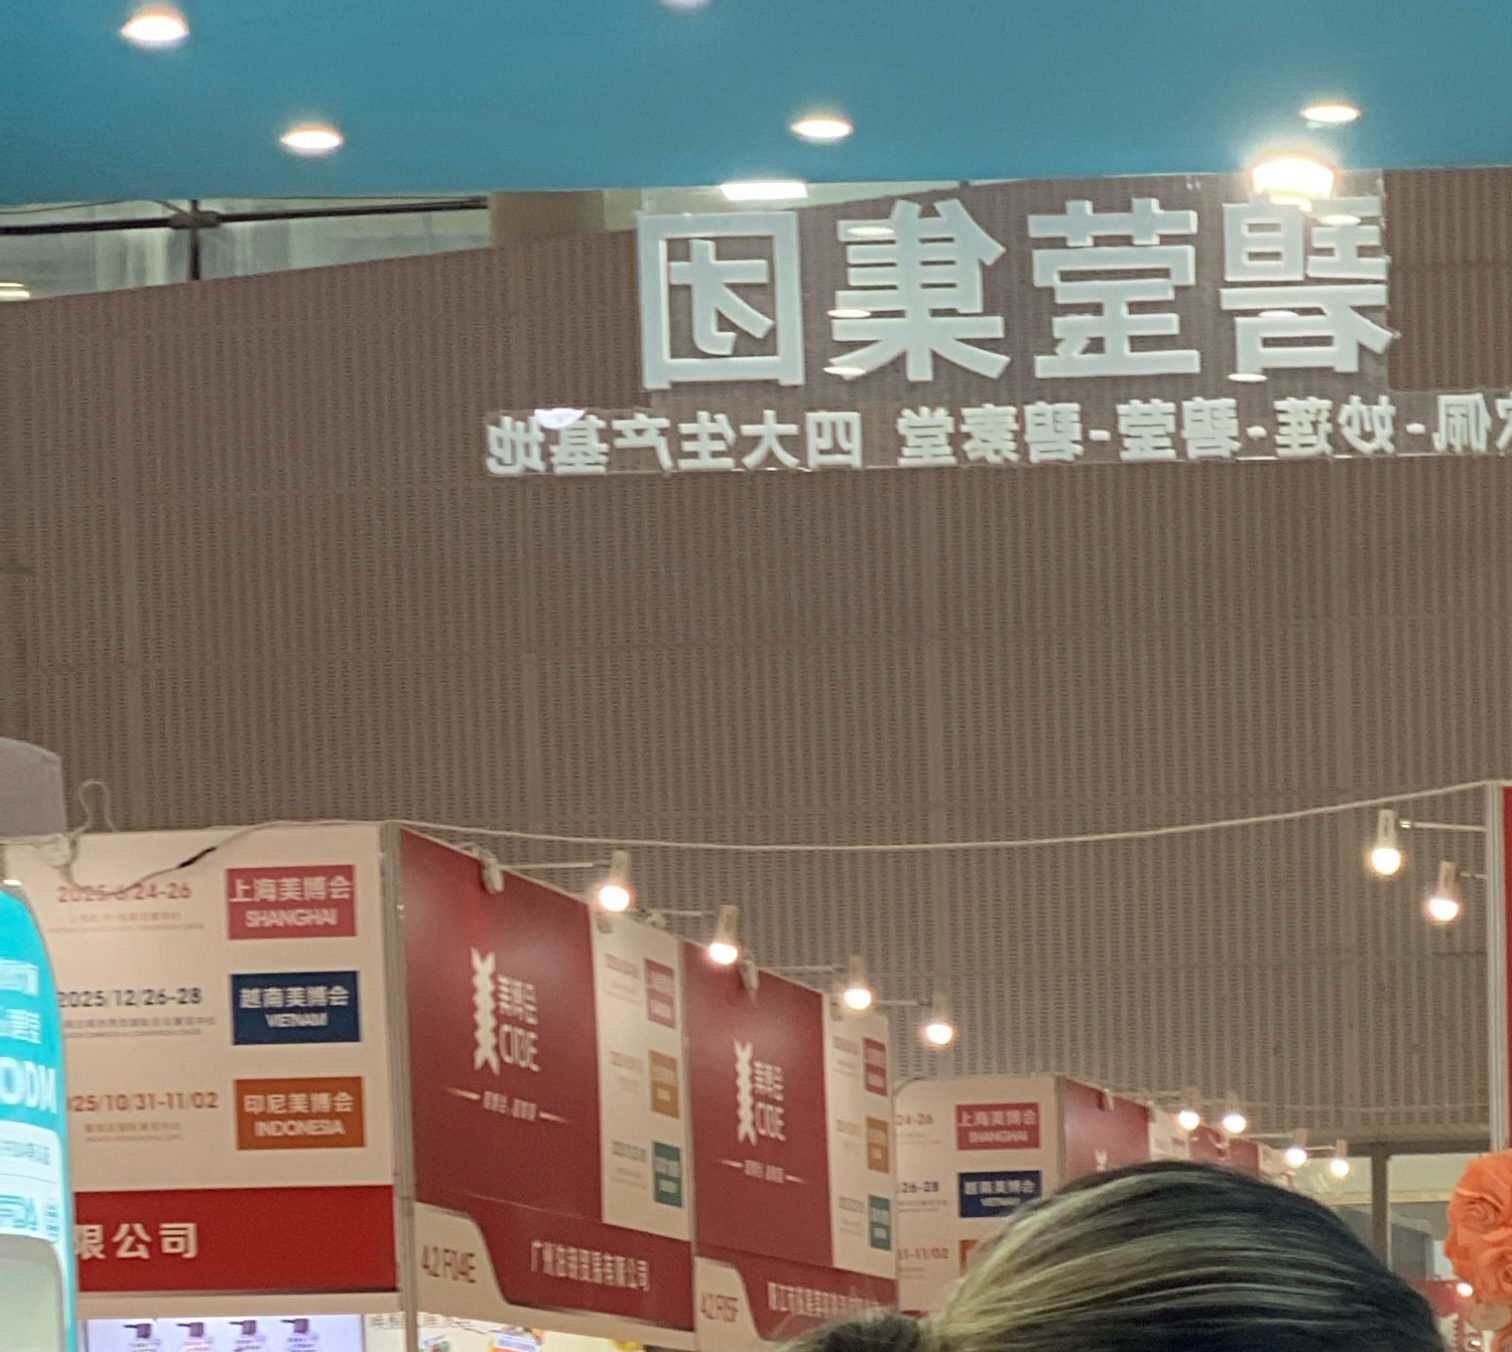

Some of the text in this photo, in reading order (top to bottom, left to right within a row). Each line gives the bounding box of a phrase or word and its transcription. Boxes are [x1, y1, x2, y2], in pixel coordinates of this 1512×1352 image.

[229, 876, 352, 902] 上海美博会
[245, 908, 337, 928] SHANGHAI
